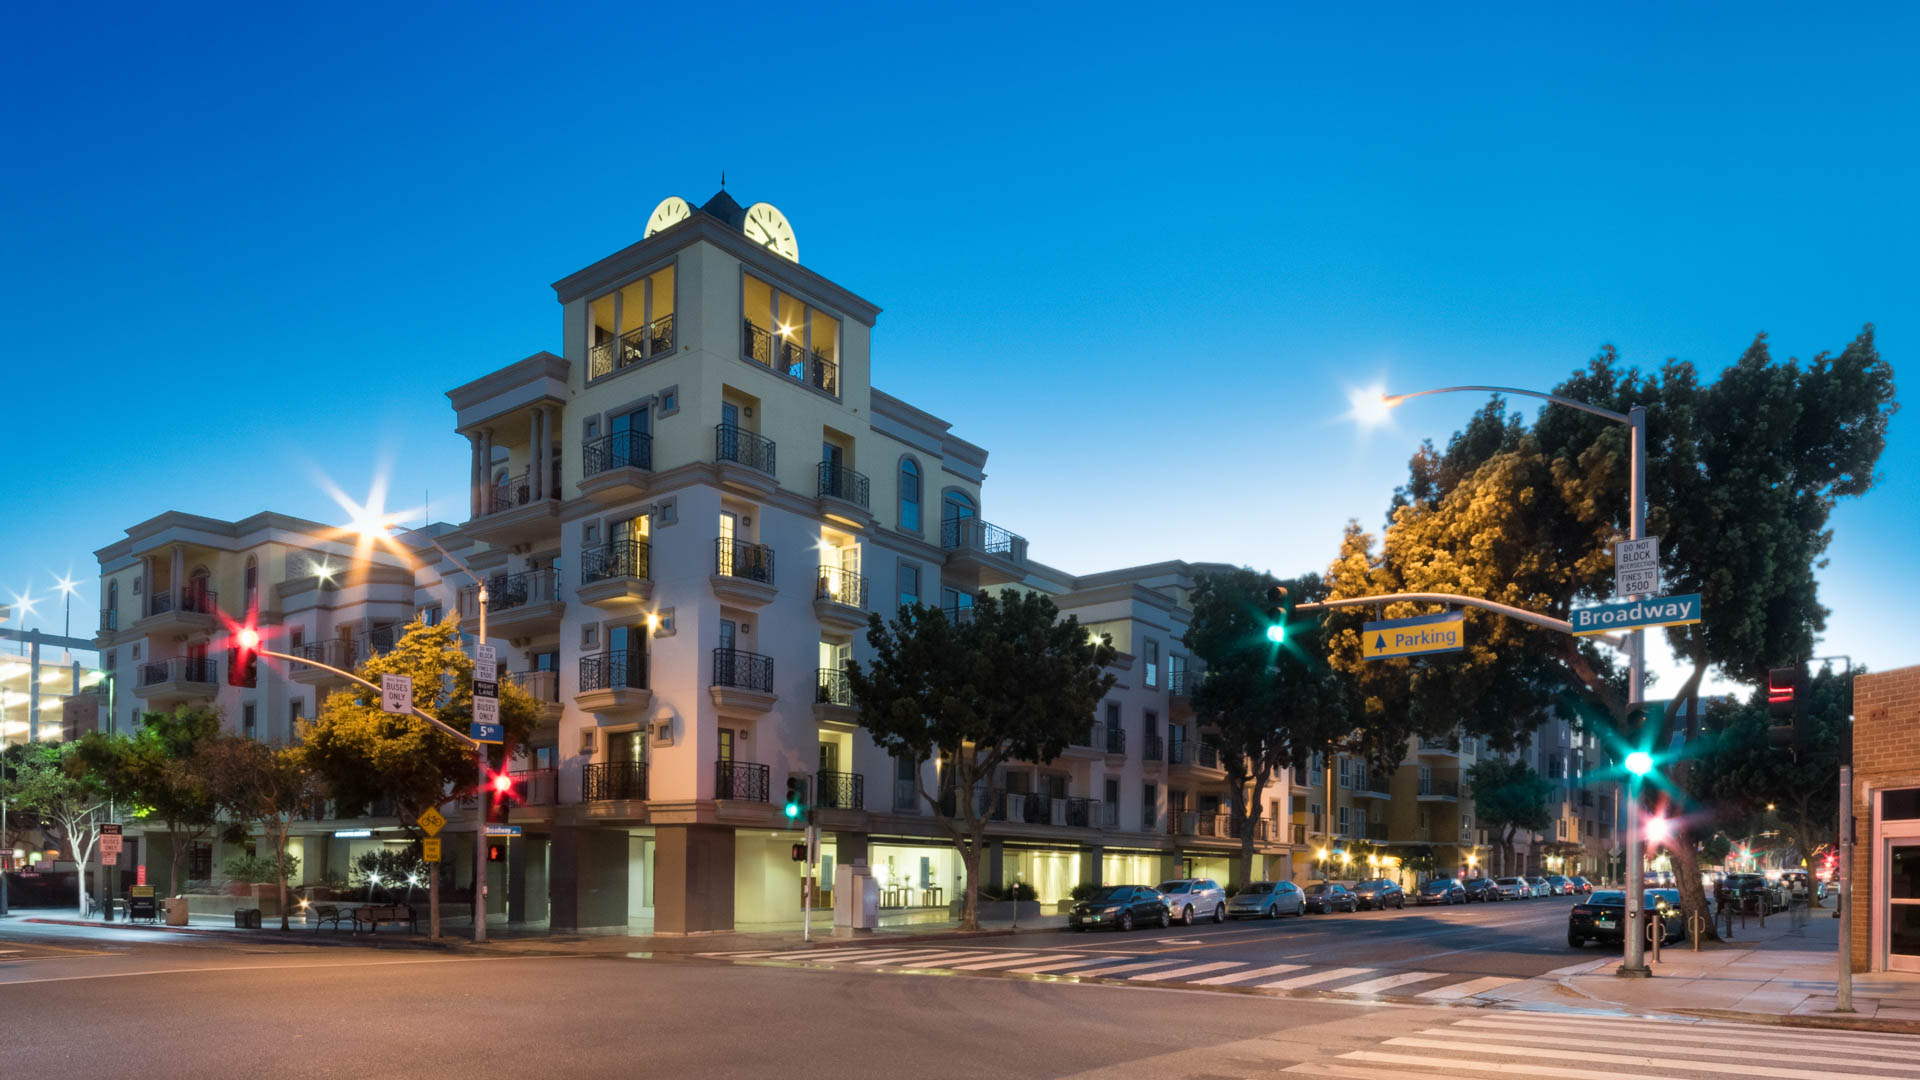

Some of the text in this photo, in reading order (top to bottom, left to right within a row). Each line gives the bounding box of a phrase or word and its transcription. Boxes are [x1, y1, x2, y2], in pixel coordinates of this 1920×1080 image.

[1624, 541, 1649, 552] DO NOT
[1623, 550, 1651, 562] BLOCK
[1619, 560, 1656, 570] INTERSECTION
[1622, 571, 1653, 582] FINES TO
[1625, 580, 1650, 592] $500
[1579, 601, 1692, 626] Broadway
[1395, 629, 1456, 648] Parking
[479, 651, 493, 659] BLOCK
[386, 682, 408, 692] BUSES
[477, 682, 495, 690] RIGHT
[389, 692, 405, 701] ONLY
[478, 689, 494, 697] LANE
[477, 703, 496, 712] BUSES
[479, 712, 494, 721] ONLY
[480, 725, 494, 737] 5th
